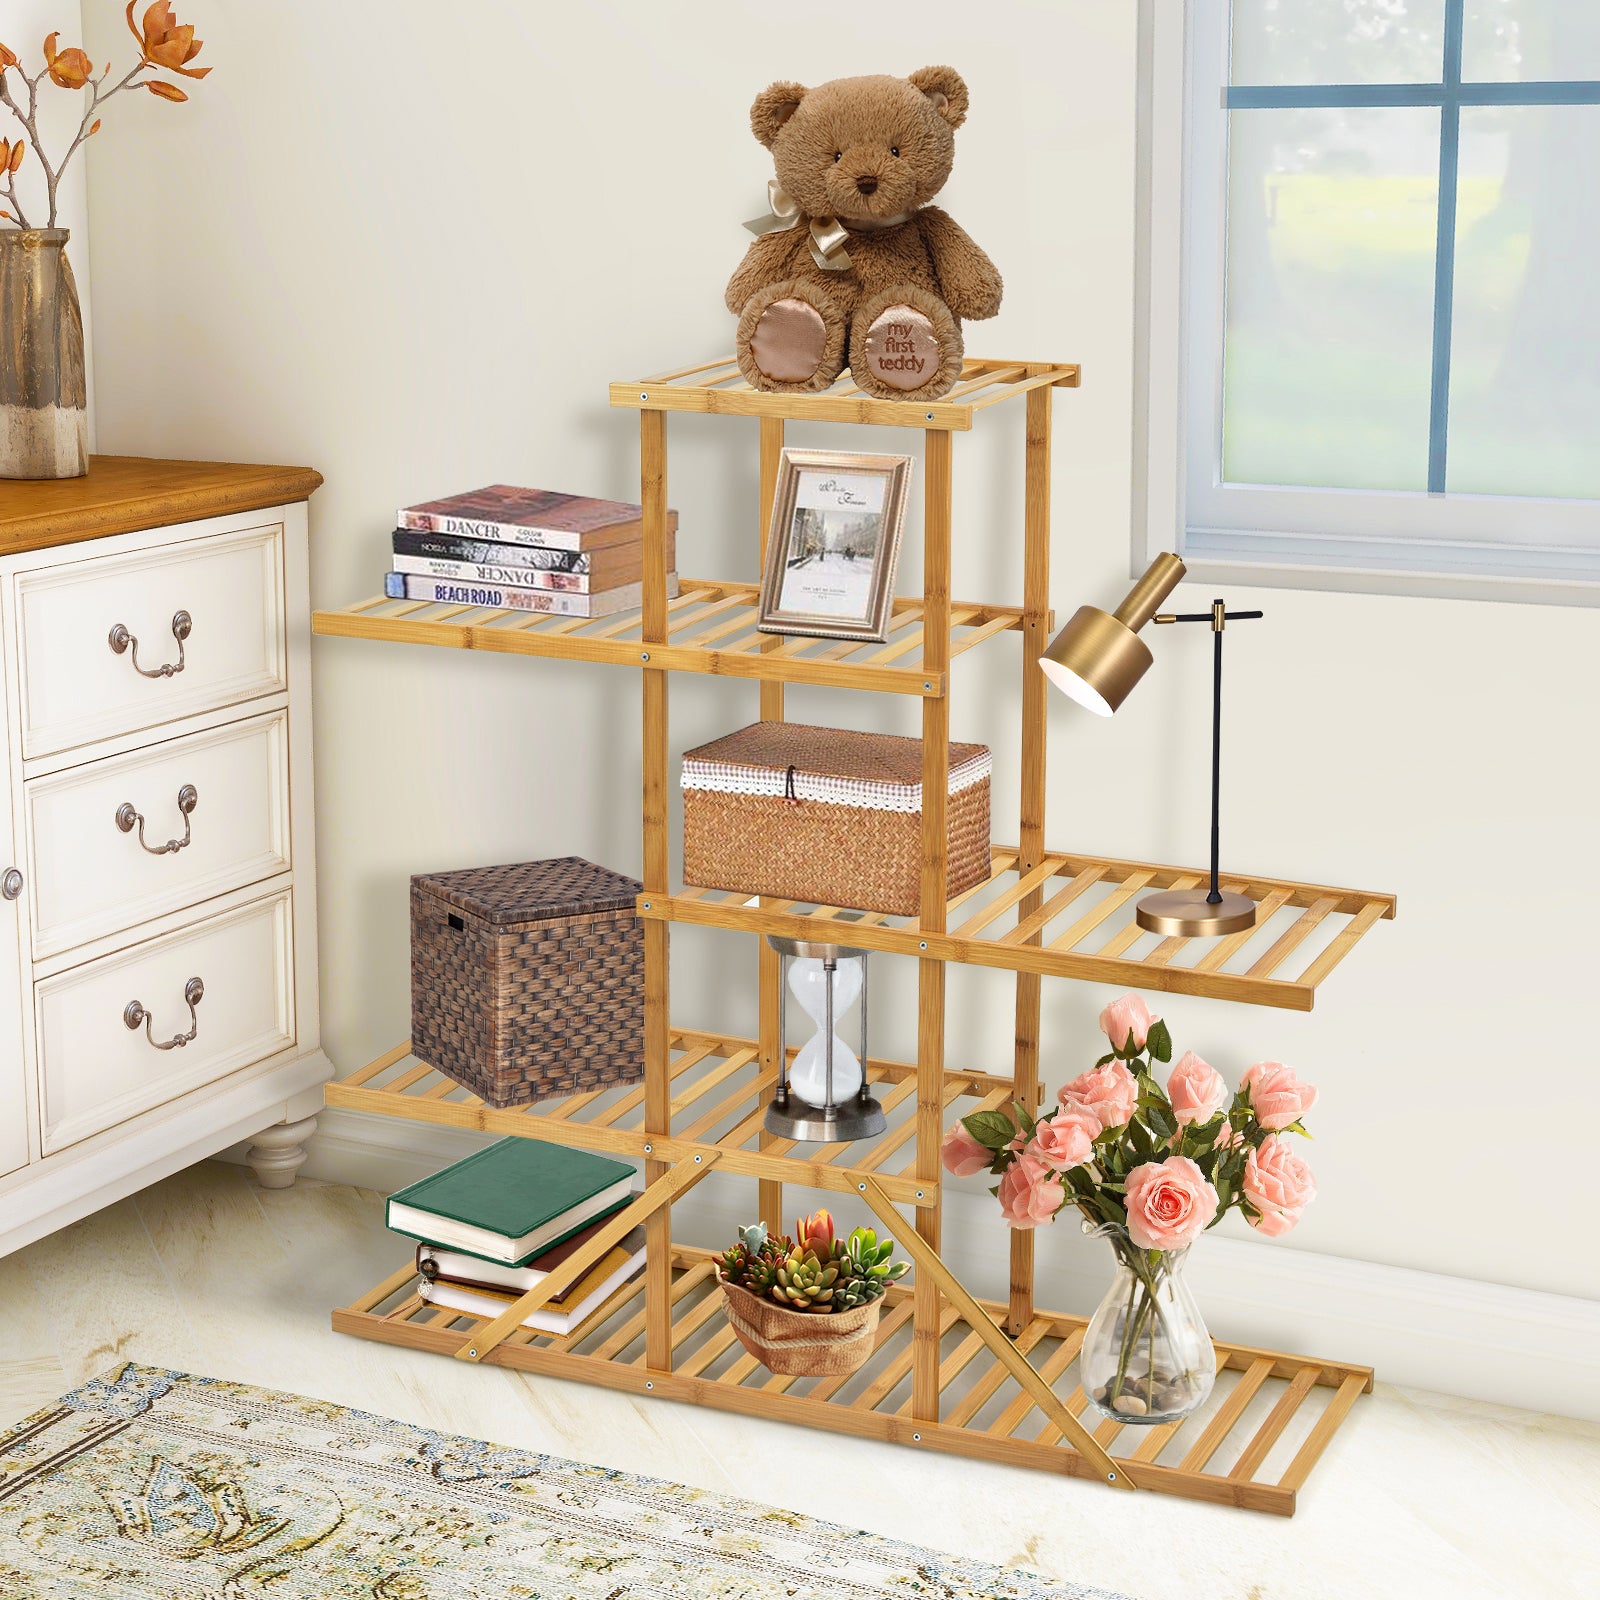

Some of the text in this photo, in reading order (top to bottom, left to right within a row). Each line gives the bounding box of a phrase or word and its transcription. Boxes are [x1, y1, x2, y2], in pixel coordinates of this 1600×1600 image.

[887, 322, 914, 339] my
[884, 336, 915, 353] first
[878, 355, 925, 374] teddy
[446, 519, 500, 539] DANCER
[476, 565, 535, 585] DANCER
[434, 584, 472, 602] BEACH
[471, 588, 502, 606] ROAD
